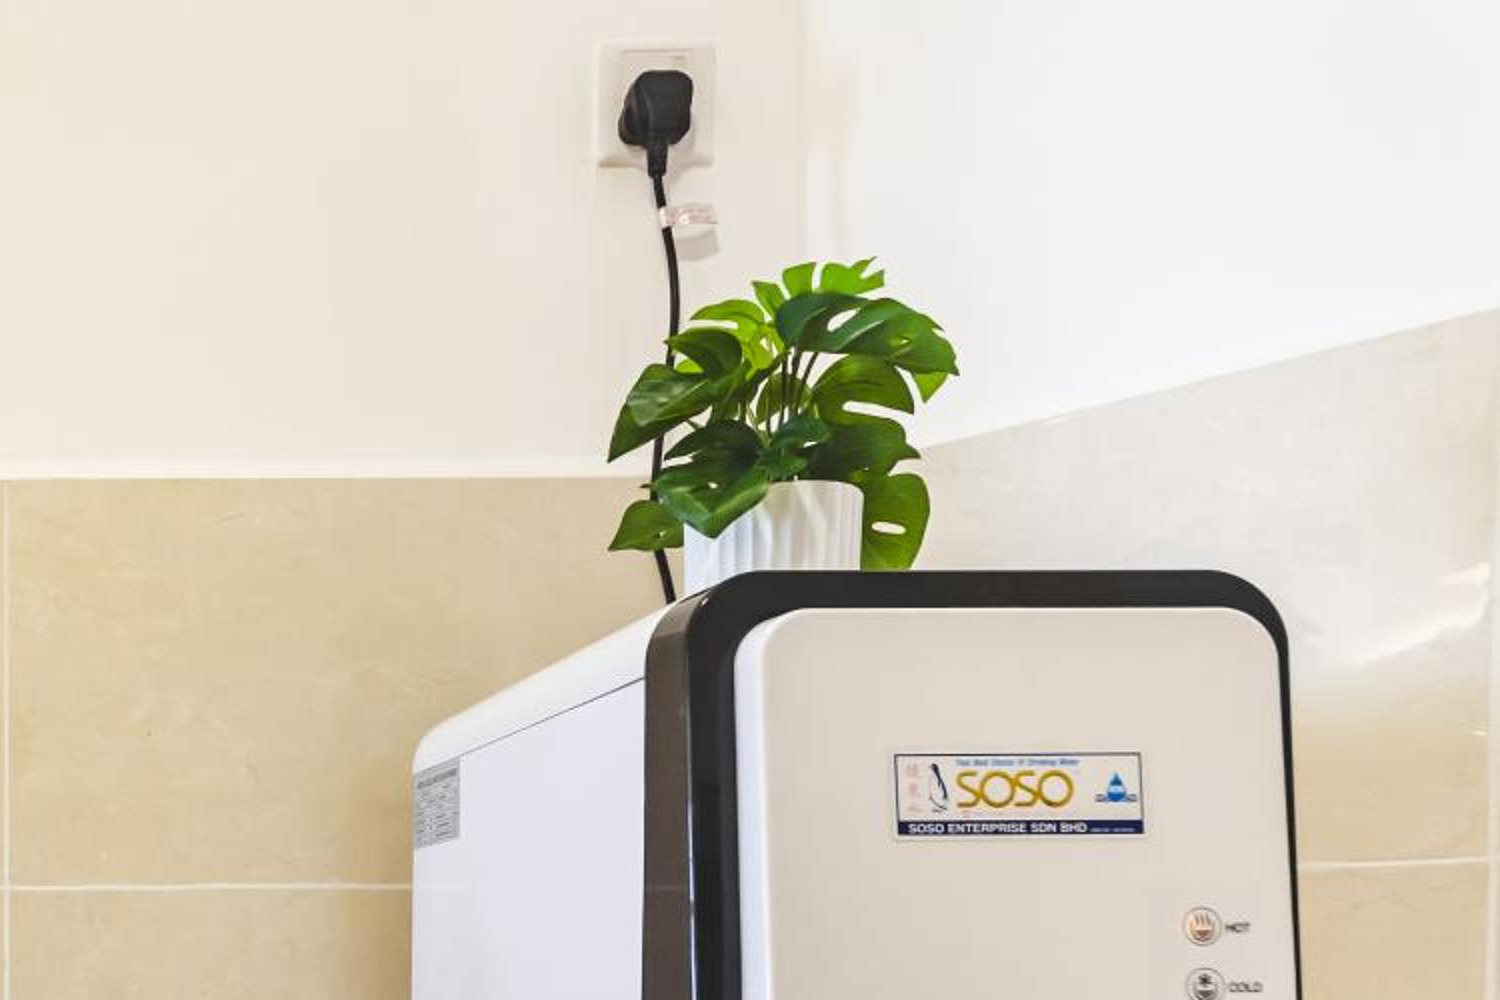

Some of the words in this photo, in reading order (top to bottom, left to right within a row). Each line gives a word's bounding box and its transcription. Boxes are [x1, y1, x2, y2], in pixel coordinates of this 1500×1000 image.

[956, 770, 1074, 808] SOSO
[908, 823, 945, 834] SOSO
[947, 823, 1027, 833] ENTERPRISE
[1030, 821, 1057, 833] SDN
[1060, 821, 1088, 833] BHD
